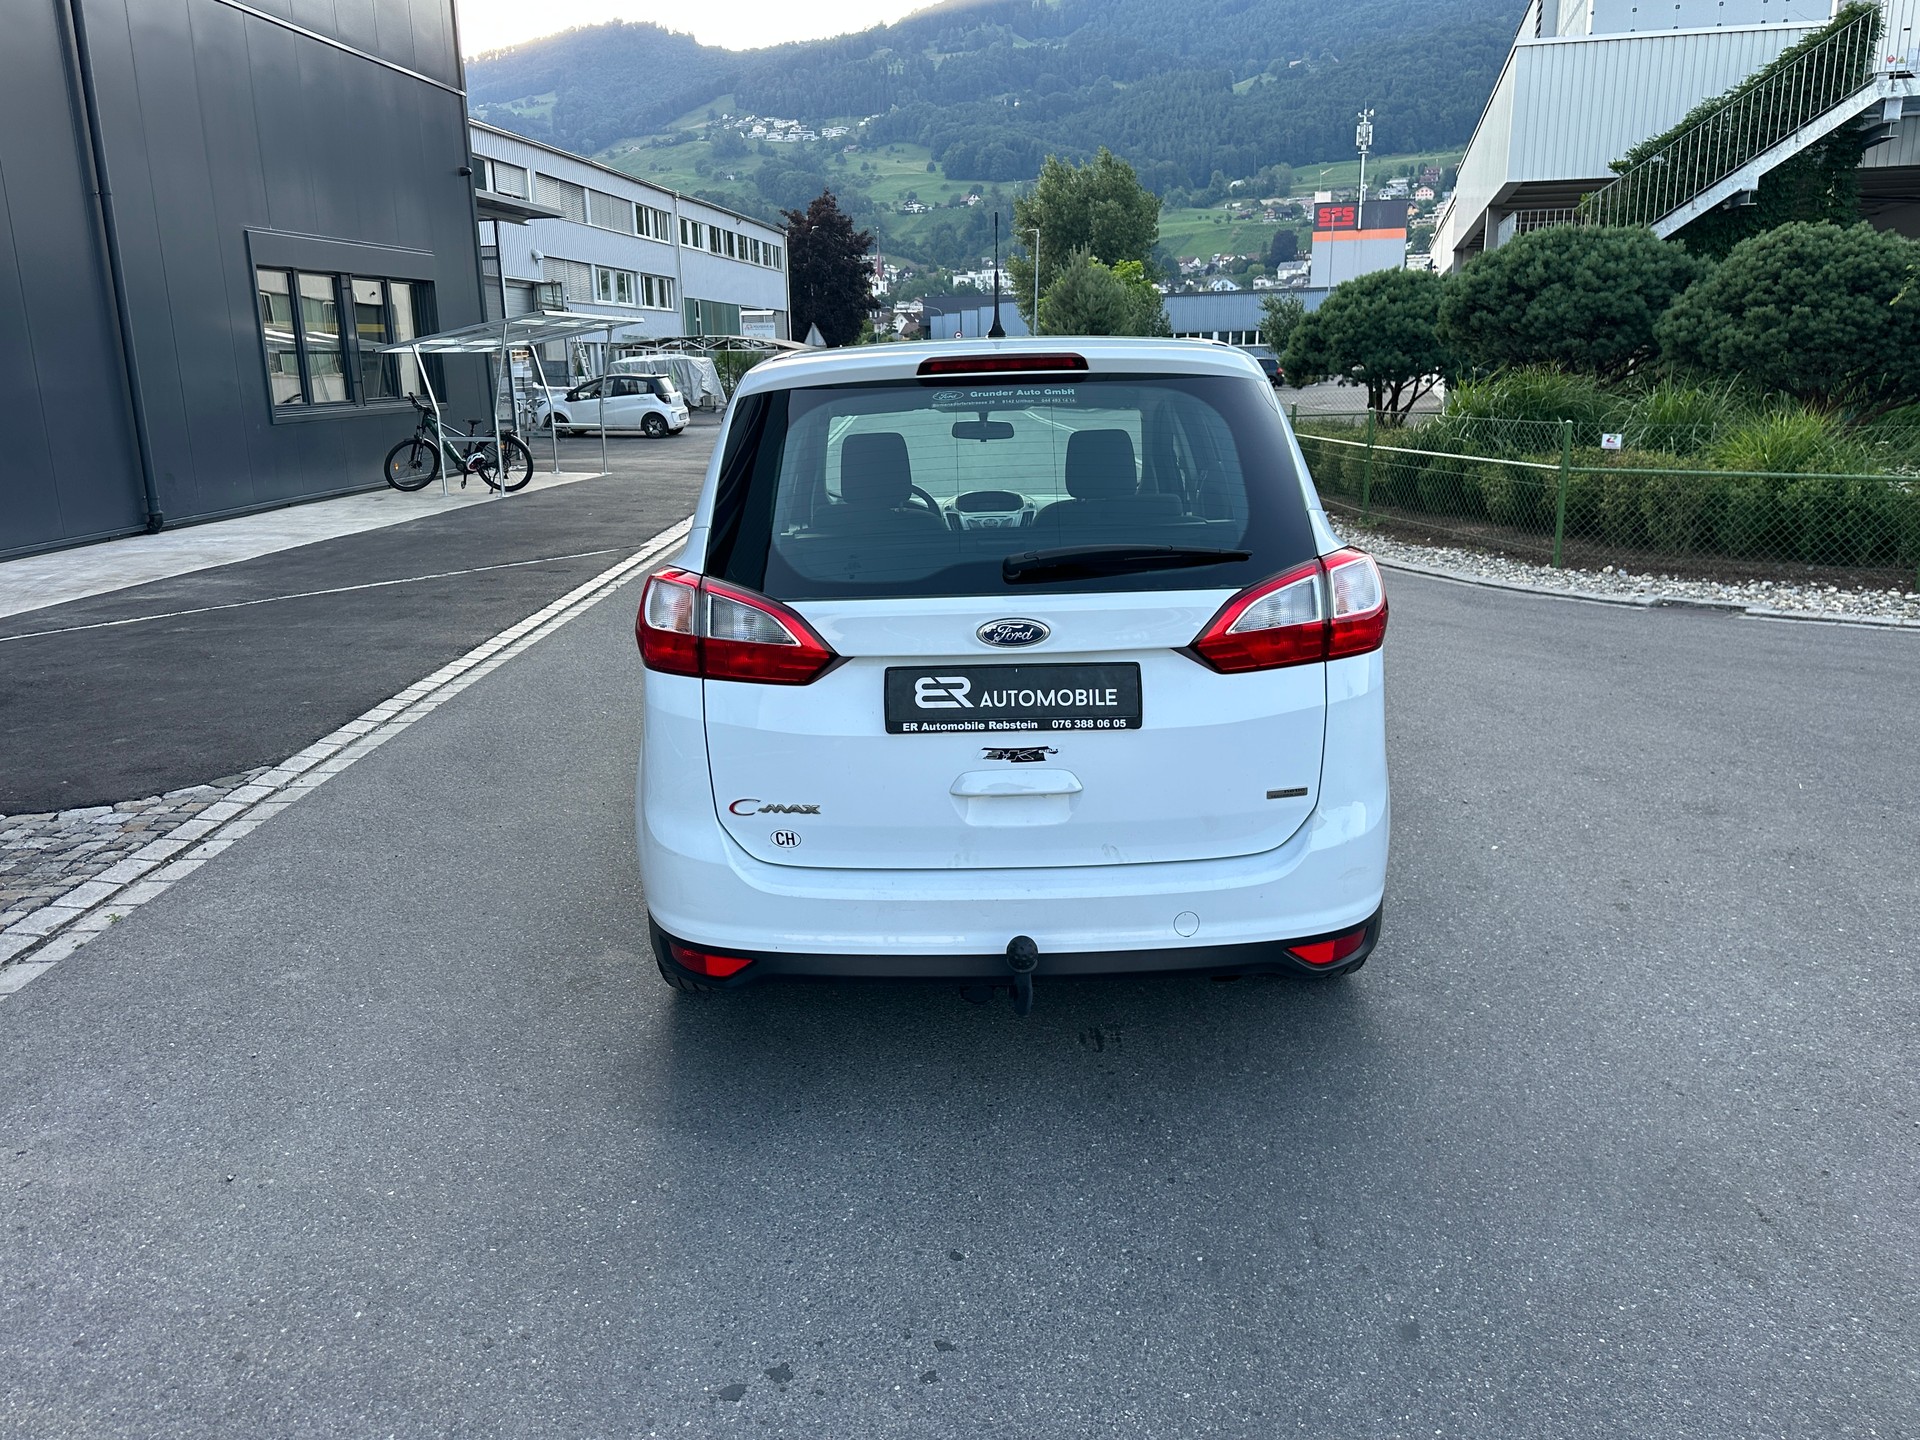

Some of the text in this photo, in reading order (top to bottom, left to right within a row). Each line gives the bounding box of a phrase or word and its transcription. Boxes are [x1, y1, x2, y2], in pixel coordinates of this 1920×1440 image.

[1318, 207, 1355, 222] SFS
[992, 624, 1034, 643] Ford
[914, 676, 1118, 708] ER AUTOMOBILE
[902, 719, 1127, 731] ER Automobile Rebstein 076 388 06 05
[776, 832, 795, 846] CH
